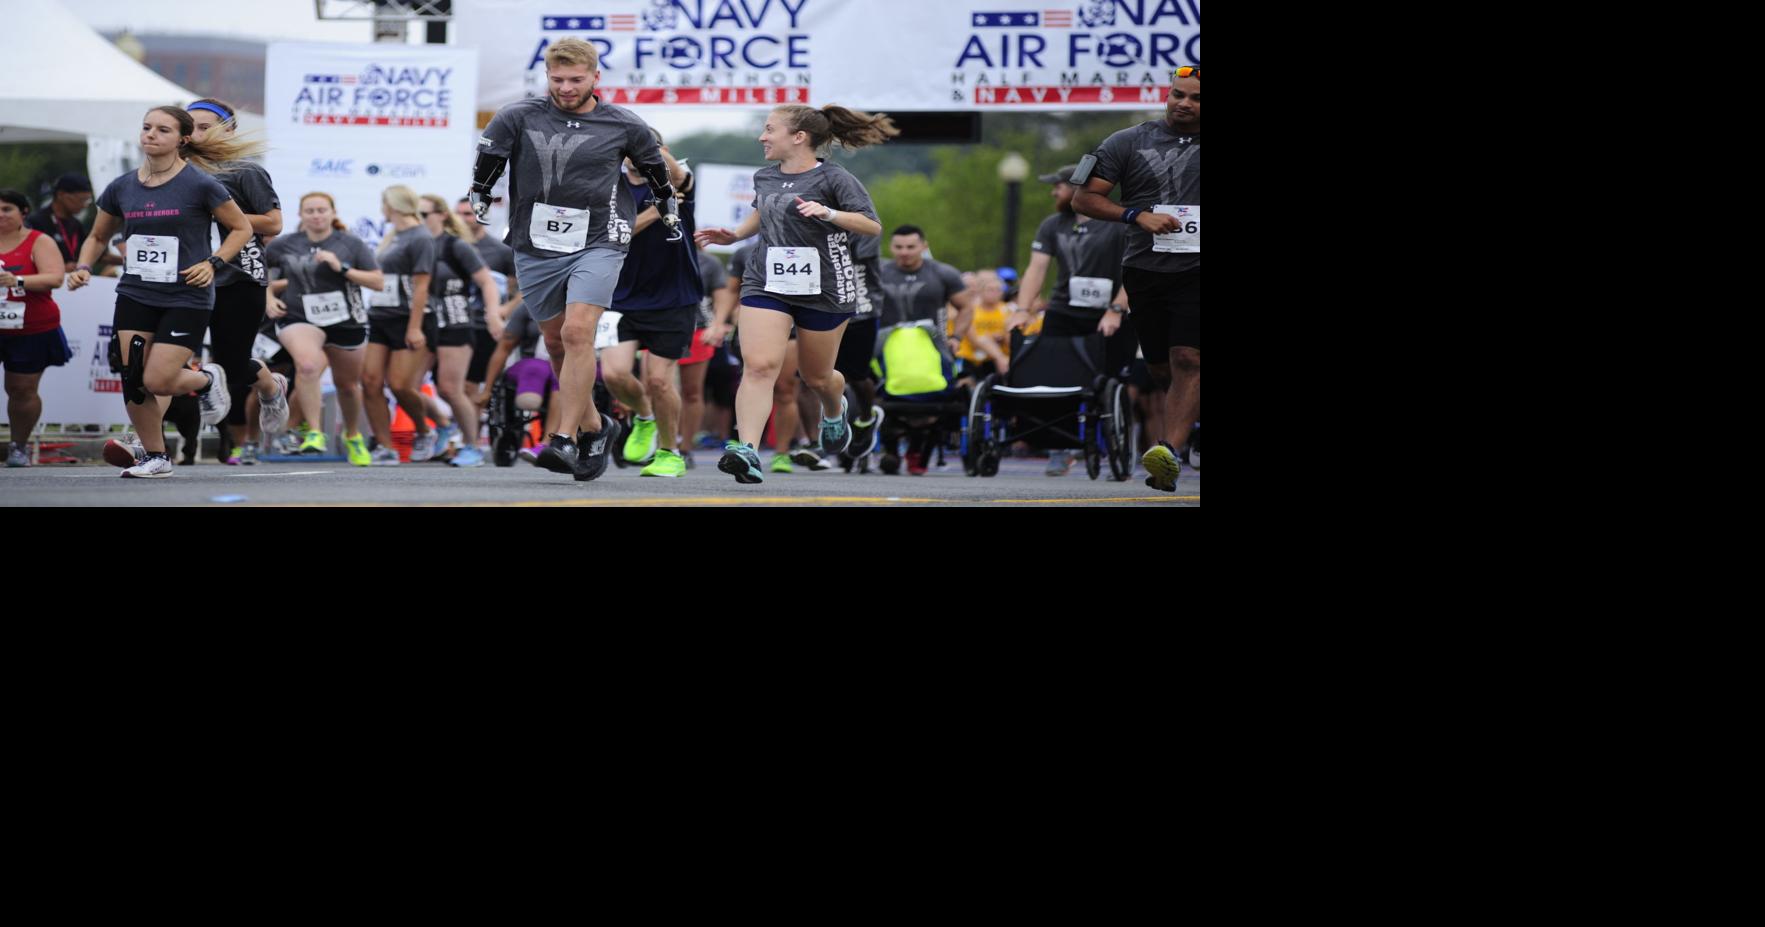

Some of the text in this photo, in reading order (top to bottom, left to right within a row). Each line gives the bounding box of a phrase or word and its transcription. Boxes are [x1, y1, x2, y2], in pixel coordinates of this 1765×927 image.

[529, 35, 808, 70] AR FORCE
[956, 33, 1200, 67] AIR FOR
[952, 72, 1031, 84] HALF
[295, 87, 450, 108] AIR FORCE
[699, 88, 802, 103] MILER
[977, 88, 1072, 103] NAVY
[547, 220, 573, 234] B7
[137, 250, 168, 264] B21
[774, 262, 813, 276] B44
[827, 233, 846, 304] WARFIGHTER
[834, 232, 856, 303] SPORTS
[311, 302, 340, 316] B42
